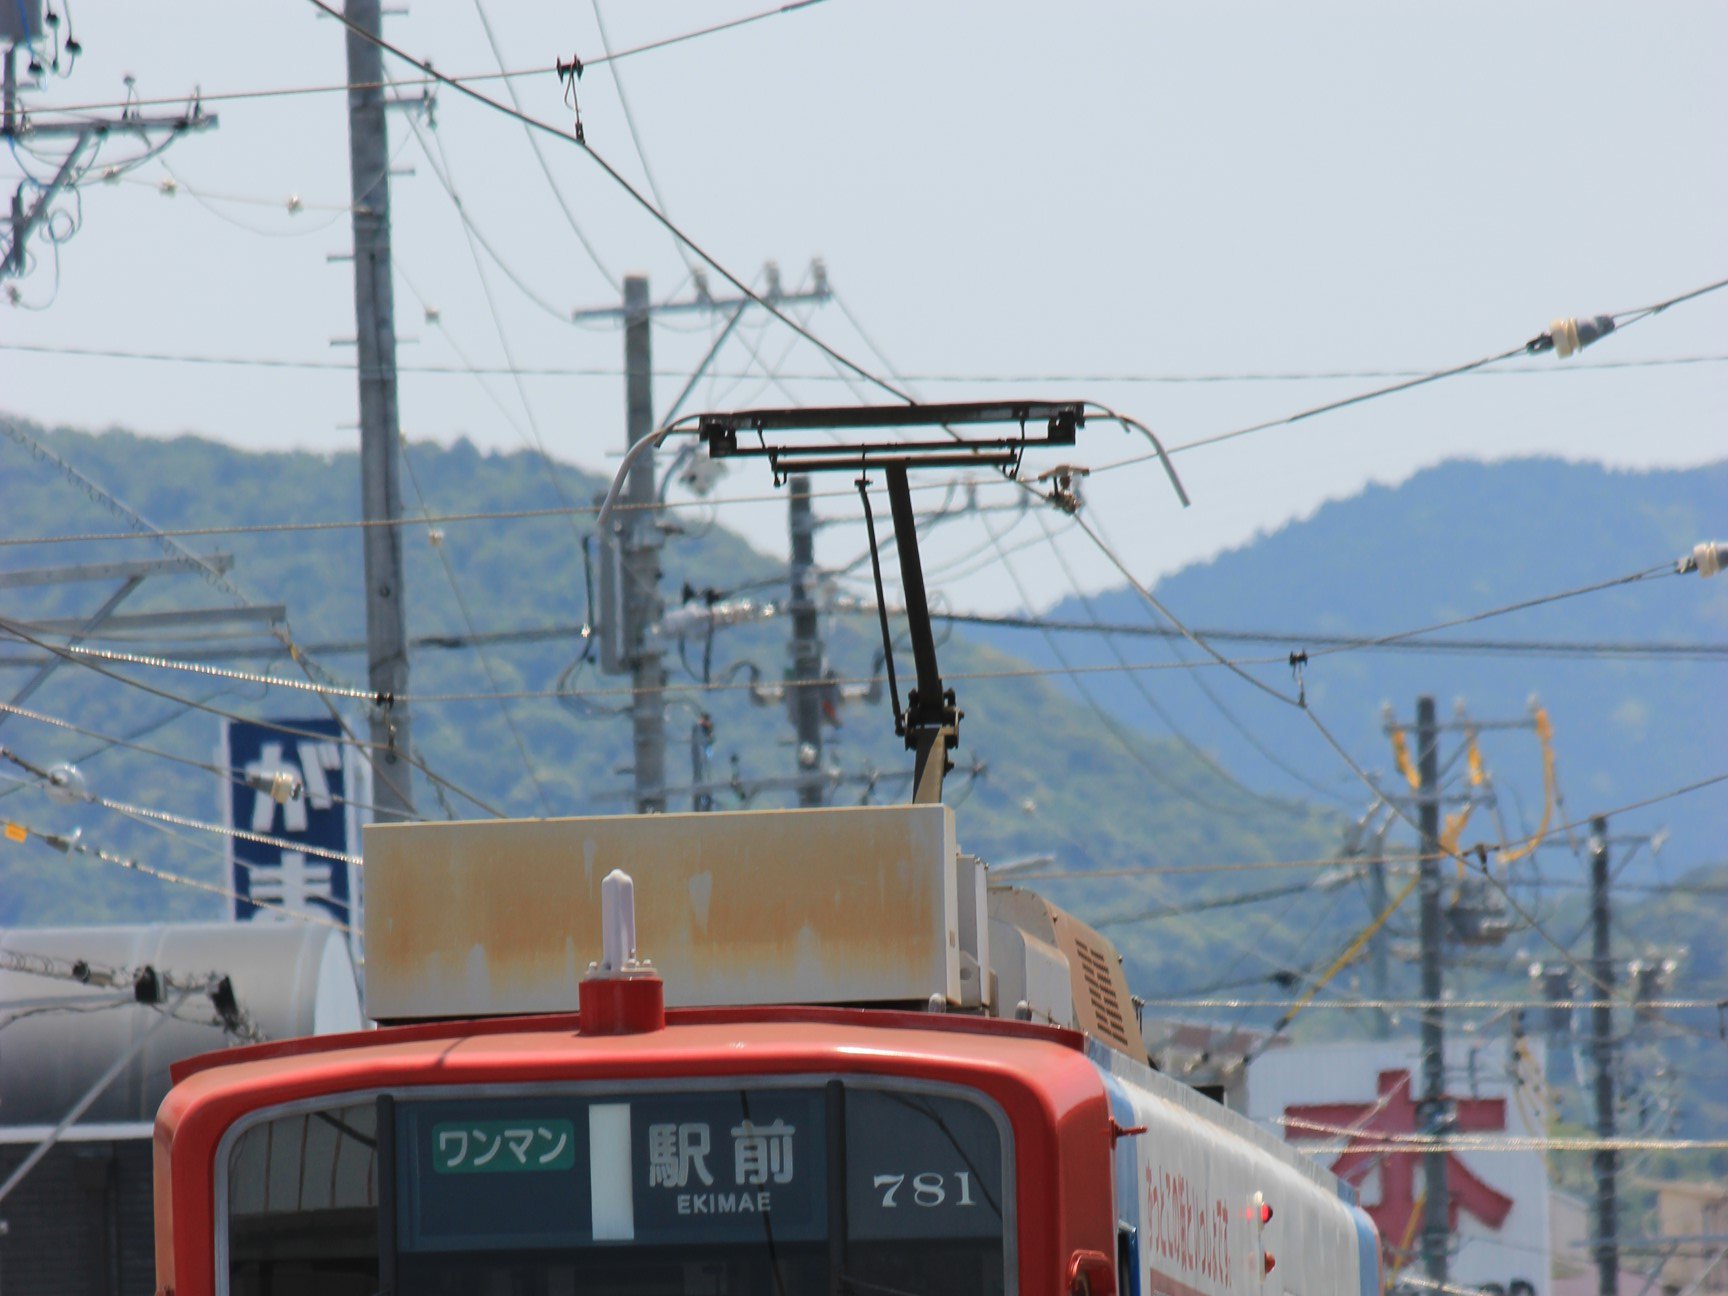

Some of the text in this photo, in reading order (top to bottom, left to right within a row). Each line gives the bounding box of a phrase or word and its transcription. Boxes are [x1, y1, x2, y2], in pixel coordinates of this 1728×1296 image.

[439, 1126, 568, 1168] ワンマン
[648, 1118, 796, 1188] 駅前
[676, 1190, 772, 1216] EKIMAE
[872, 1170, 978, 1209] 781
